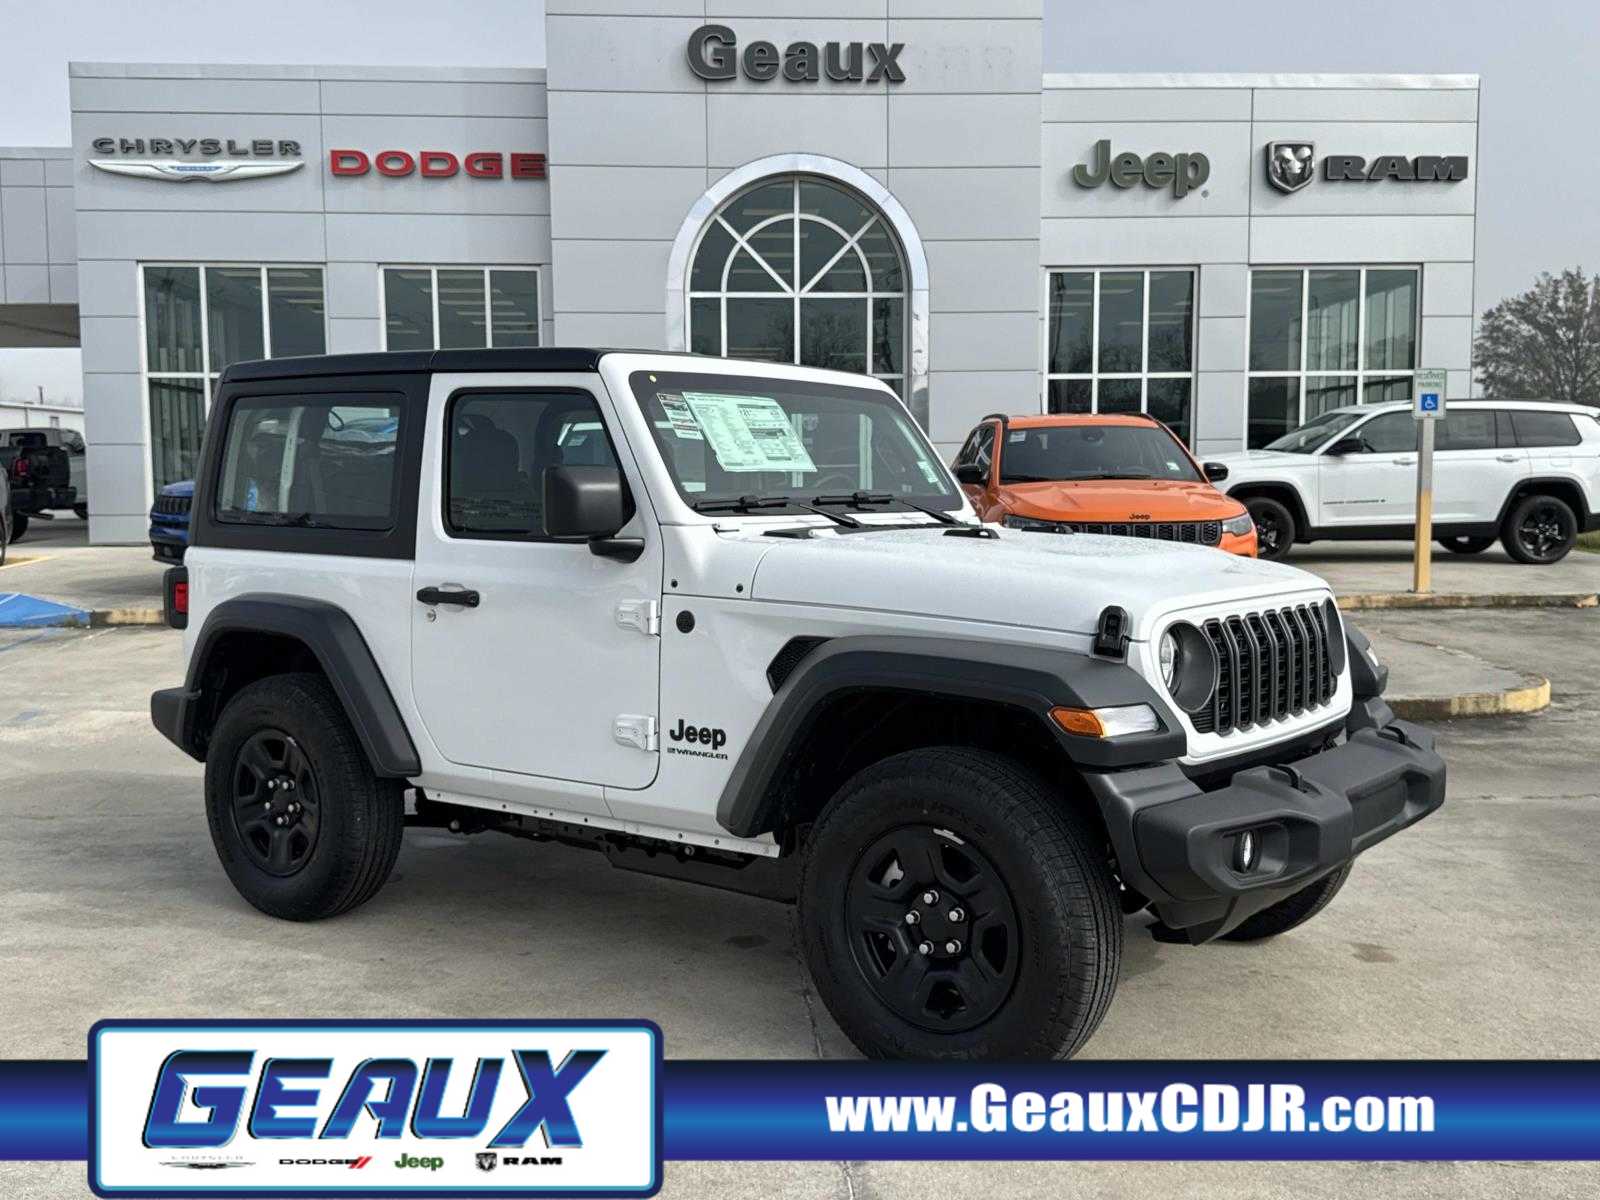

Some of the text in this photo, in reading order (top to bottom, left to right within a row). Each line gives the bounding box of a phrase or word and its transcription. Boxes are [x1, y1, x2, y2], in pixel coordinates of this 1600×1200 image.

[687, 24, 906, 82] Geaux
[92, 138, 303, 156] CHRYSLER
[330, 150, 547, 181] DODGE
[1072, 139, 1210, 198] Jeep
[1325, 156, 1469, 181] RAM
[669, 718, 727, 750] Jeep
[676, 748, 728, 760] WRANGLER
